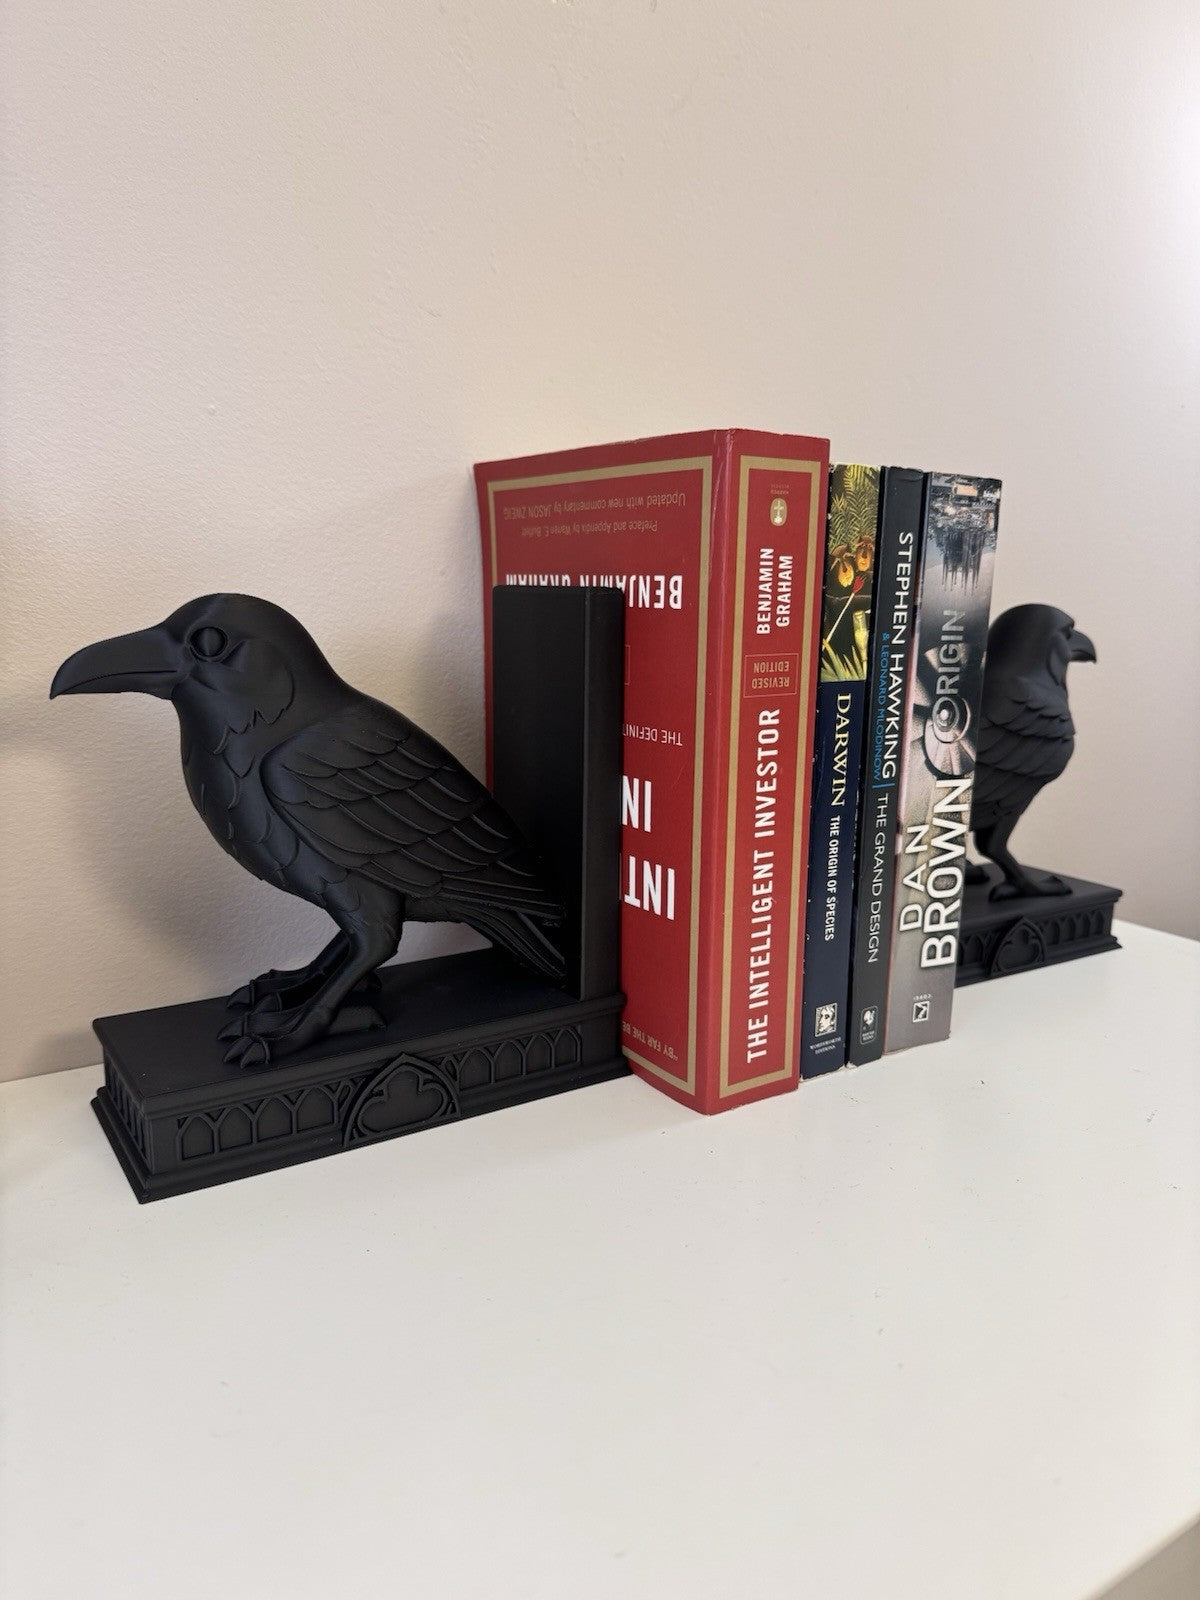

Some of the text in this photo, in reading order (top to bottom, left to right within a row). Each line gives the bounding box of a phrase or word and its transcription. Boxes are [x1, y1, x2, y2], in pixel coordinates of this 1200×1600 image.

[503, 492, 686, 520] Updated with new commentary by JASON ZWEIG
[581, 521, 612, 534] Appendix
[613, 522, 627, 533] and
[628, 520, 658, 532] Preface
[756, 548, 774, 635] BENJAMIN
[776, 555, 793, 627] GRAHAM
[752, 676, 790, 689] REVISED
[753, 661, 790, 674] EDITION
[882, 531, 913, 779] STEPHEN HAWKING
[931, 610, 966, 732] ORIGIN
[661, 729, 683, 746] THE
[873, 633, 890, 780] & LEONARD MLODINOW
[831, 693, 851, 806] DARWIN
[625, 856, 675, 920] INT
[747, 708, 780, 1063] THE INTELLIGENT INVESTOR
[824, 815, 840, 941] THE ORIGIN OF SPECIES
[868, 792, 888, 963] THE GRAND DESIGN
[900, 825, 929, 933] DAN
[920, 778, 972, 969] BROWN
[632, 1026, 646, 1044] THE
[647, 1035, 661, 1052] FAR
